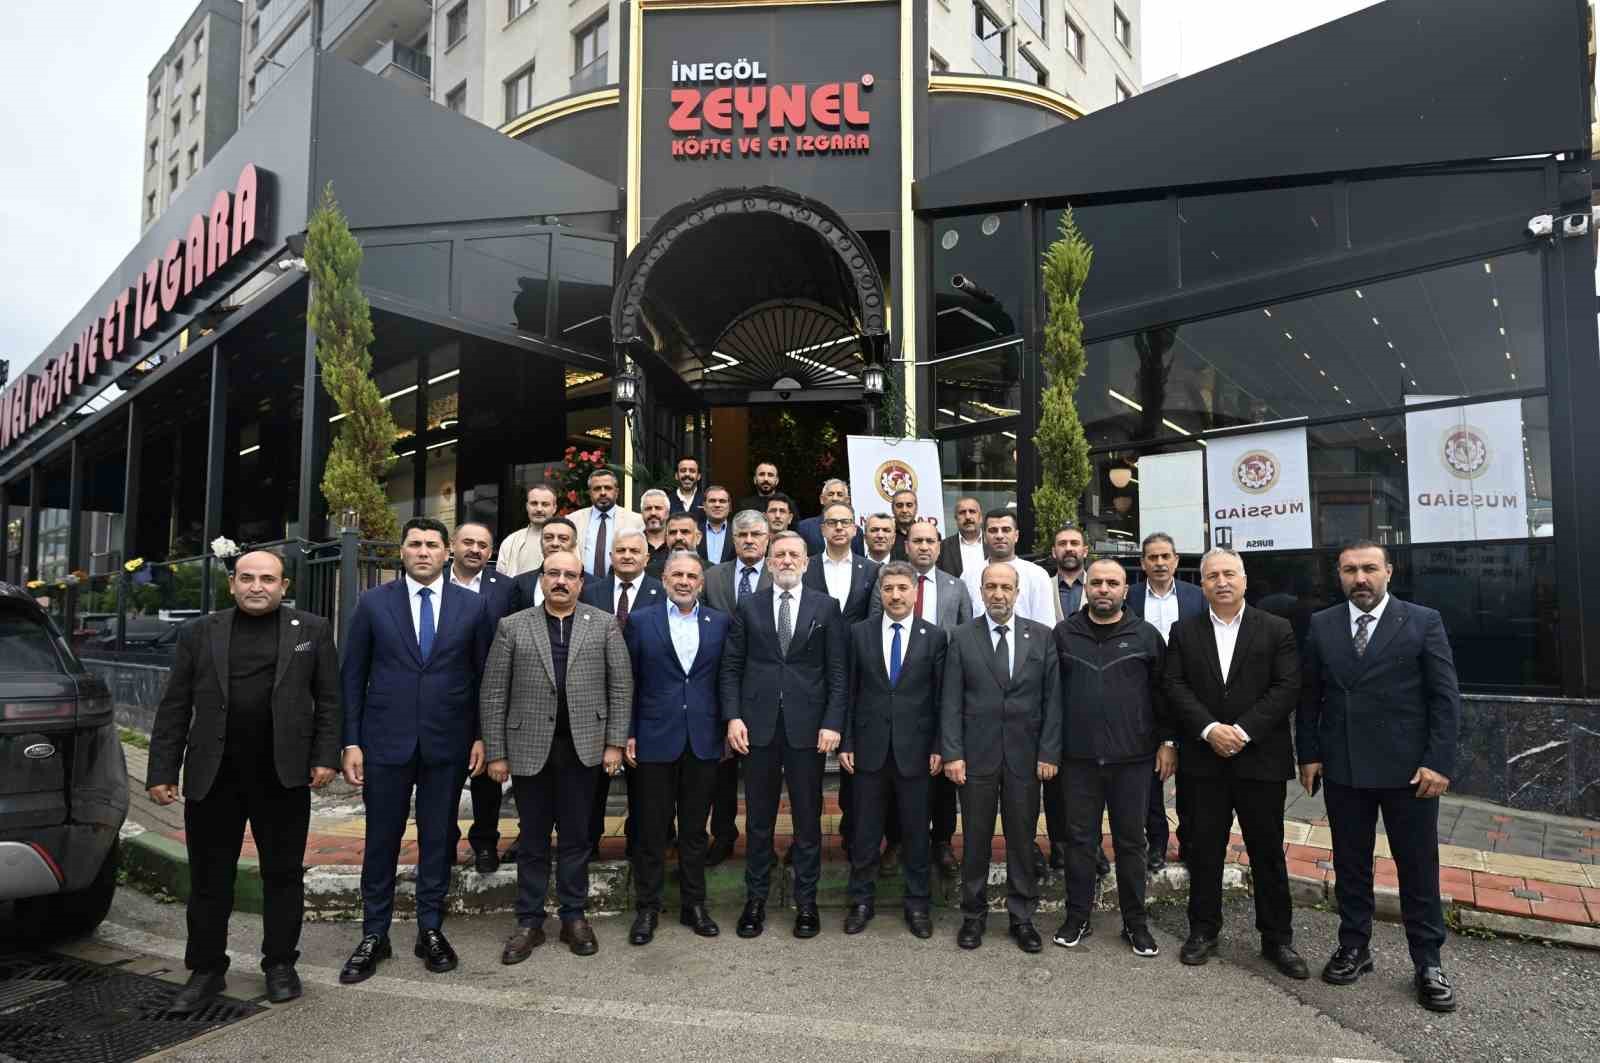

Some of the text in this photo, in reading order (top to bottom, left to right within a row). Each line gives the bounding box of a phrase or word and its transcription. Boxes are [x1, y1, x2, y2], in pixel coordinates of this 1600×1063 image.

[671, 58, 767, 81] İNEGÖL
[669, 83, 870, 130] ZEYNEL
[671, 133, 870, 155] KÖFTE VE ET IZGARA
[78, 316, 102, 385] VE
[102, 287, 130, 361] ET
[133, 162, 257, 338] IZGARA
